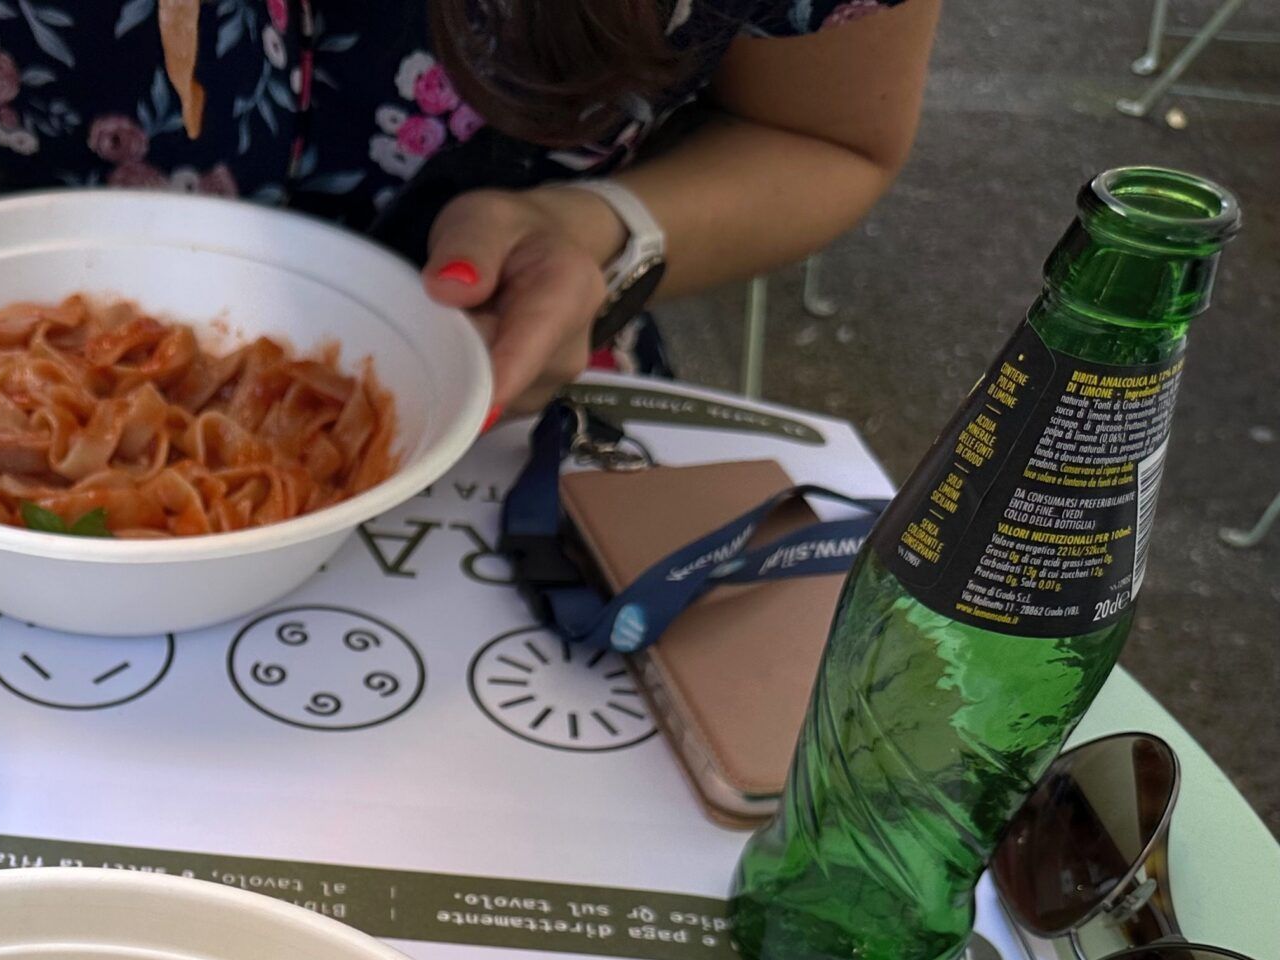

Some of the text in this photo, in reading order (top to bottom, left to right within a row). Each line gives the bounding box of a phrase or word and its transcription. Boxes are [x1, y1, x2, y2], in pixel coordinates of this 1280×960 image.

[1001, 362, 1029, 386] CONTIENE
[1071, 370, 1098, 386] BIBITA
[1100, 376, 1148, 388] ANALCOLICA
[992, 387, 1018, 409] LIMONE
[1065, 382, 1113, 399] DI LIMONE
[1055, 405, 1074, 417] succo
[1077, 407, 1084, 419] di
[1087, 409, 1111, 421] limone
[1060, 395, 1089, 408] naturale
[1113, 399, 1120, 410] di
[1043, 426, 1098, 443] polpa di limone
[1050, 415, 1078, 430] sciroppo
[1083, 420, 1091, 432] di
[1034, 444, 1054, 459] fondo
[1060, 452, 1084, 464] dovuta
[1039, 435, 1054, 447] altri
[1055, 440, 1077, 452] aromi
[1008, 498, 1034, 513] ENTRO
[1061, 508, 1084, 520] (VEDI
[1014, 487, 1137, 509] DA CONSUMARSI PREFERIBILMENTE
[1003, 508, 1028, 523] COLLO
[1029, 515, 1053, 528] DELLA
[1054, 519, 1096, 531] BOTTIGLIA)
[991, 533, 1015, 549] Valore
[1015, 542, 1056, 556] energetico
[997, 522, 1109, 545] VALORI NUTRIZIONALI PER
[980, 554, 1021, 575] Carboidrati
[1022, 564, 1038, 578] 13g
[1038, 567, 1047, 578] di
[1047, 569, 1059, 579] cui
[1060, 567, 1090, 580] zuccheri
[985, 544, 1008, 560] Grassi
[1008, 550, 1020, 564] 0g
[1020, 552, 1030, 564] di
[1030, 556, 1041, 566] cui
[1043, 556, 1060, 567] acidi
[1062, 557, 1084, 570] grassi
[974, 567, 1005, 583] Proteine
[1020, 577, 1038, 590] Sale
[966, 579, 1016, 601] Terme di Crodo
[961, 590, 972, 601] Via
[1005, 601, 1015, 612] 11
[1019, 604, 1044, 617] 28862
[211, 870, 305, 893] tavolo,
[320, 881, 347, 896] al
[454, 892, 552, 913] tavolo.
[567, 901, 612, 918] sul
[627, 904, 656, 924] Qr
[436, 909, 719, 947] e paga direttamente
